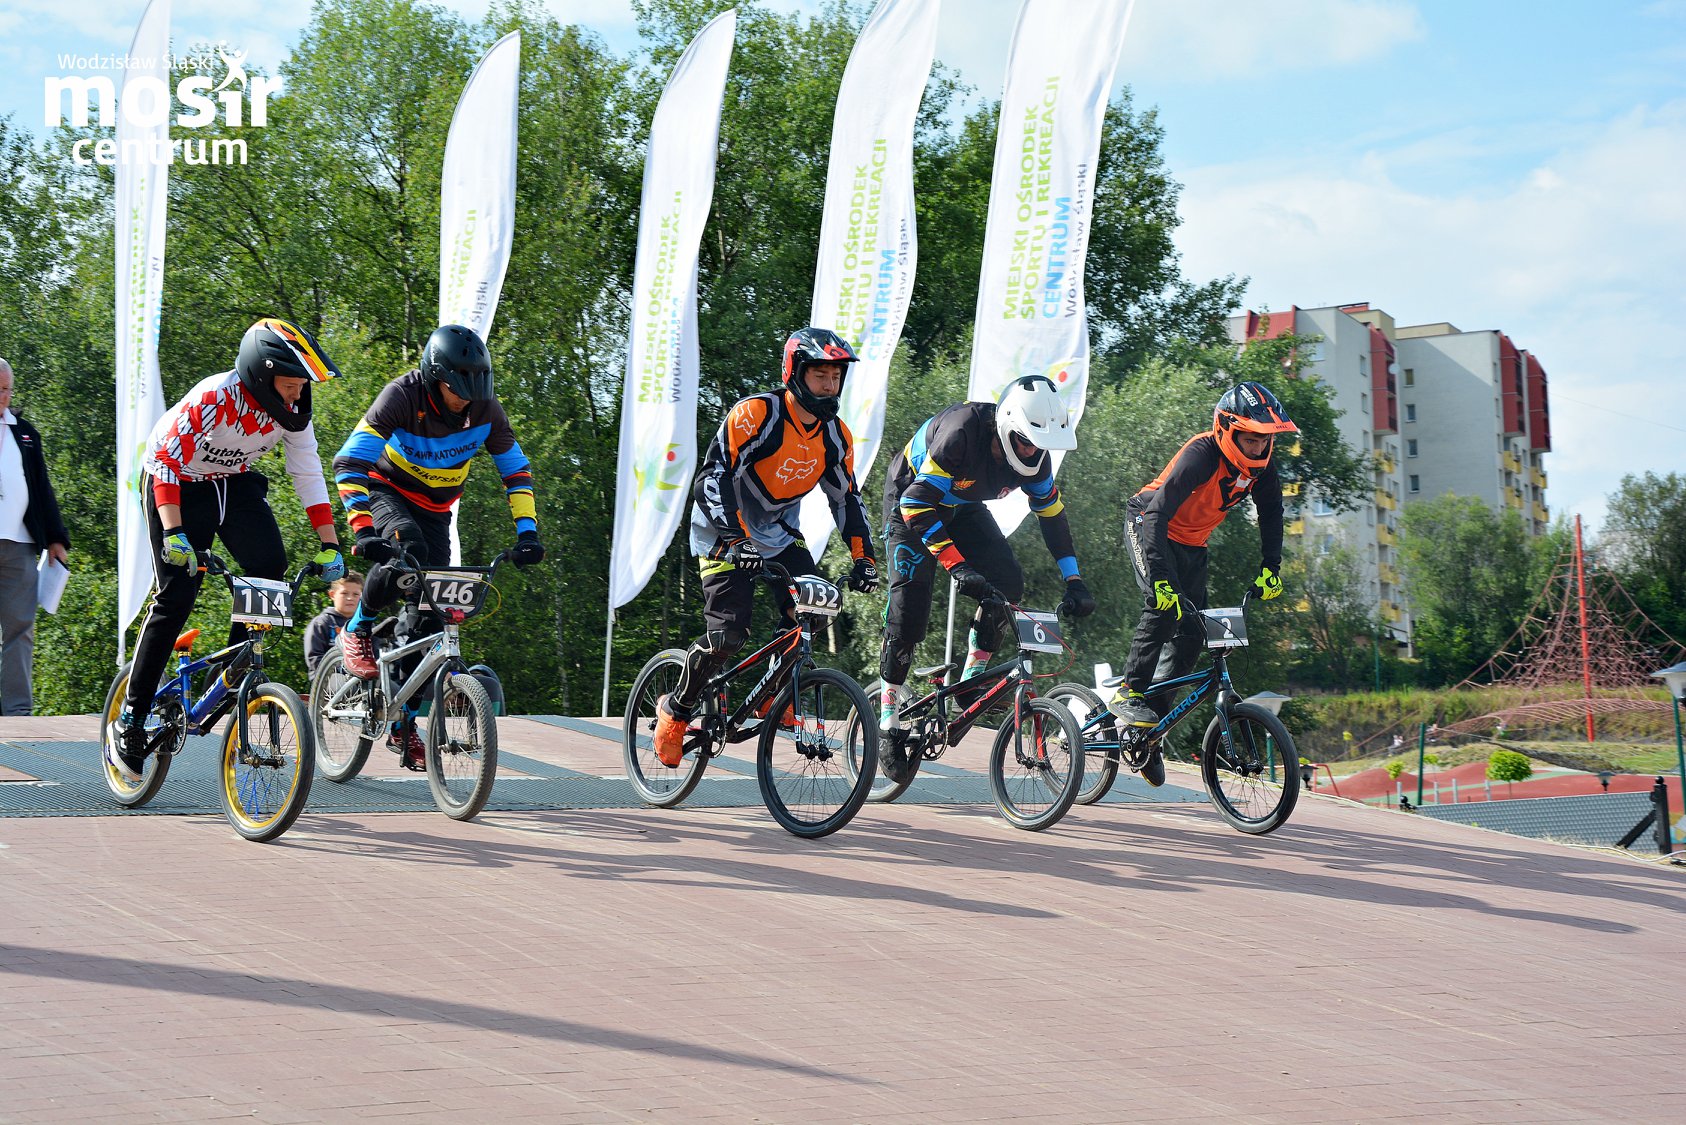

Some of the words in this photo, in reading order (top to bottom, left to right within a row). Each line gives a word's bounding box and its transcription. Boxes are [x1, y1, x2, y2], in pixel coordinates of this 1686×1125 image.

[843, 163, 868, 271] OŚRODEK
[862, 138, 887, 252] REKREACJI
[1003, 229, 1029, 320] MIEJSKI
[1016, 104, 1039, 223] OŚRODEK
[1021, 224, 1047, 320] SPORTU
[1035, 75, 1061, 203] REKREACJI
[648, 215, 671, 317] OŚRODEK
[1042, 197, 1072, 319] CENTRUM
[835, 277, 856, 341] IEJSKI
[867, 249, 897, 361] CENTRUM
[241, 588, 288, 617] 114
[431, 581, 474, 605] 146
[805, 582, 839, 608] 132
[1033, 622, 1046, 644] 6
[1221, 617, 1234, 639] 2
[1164, 691, 1199, 725] HARO
